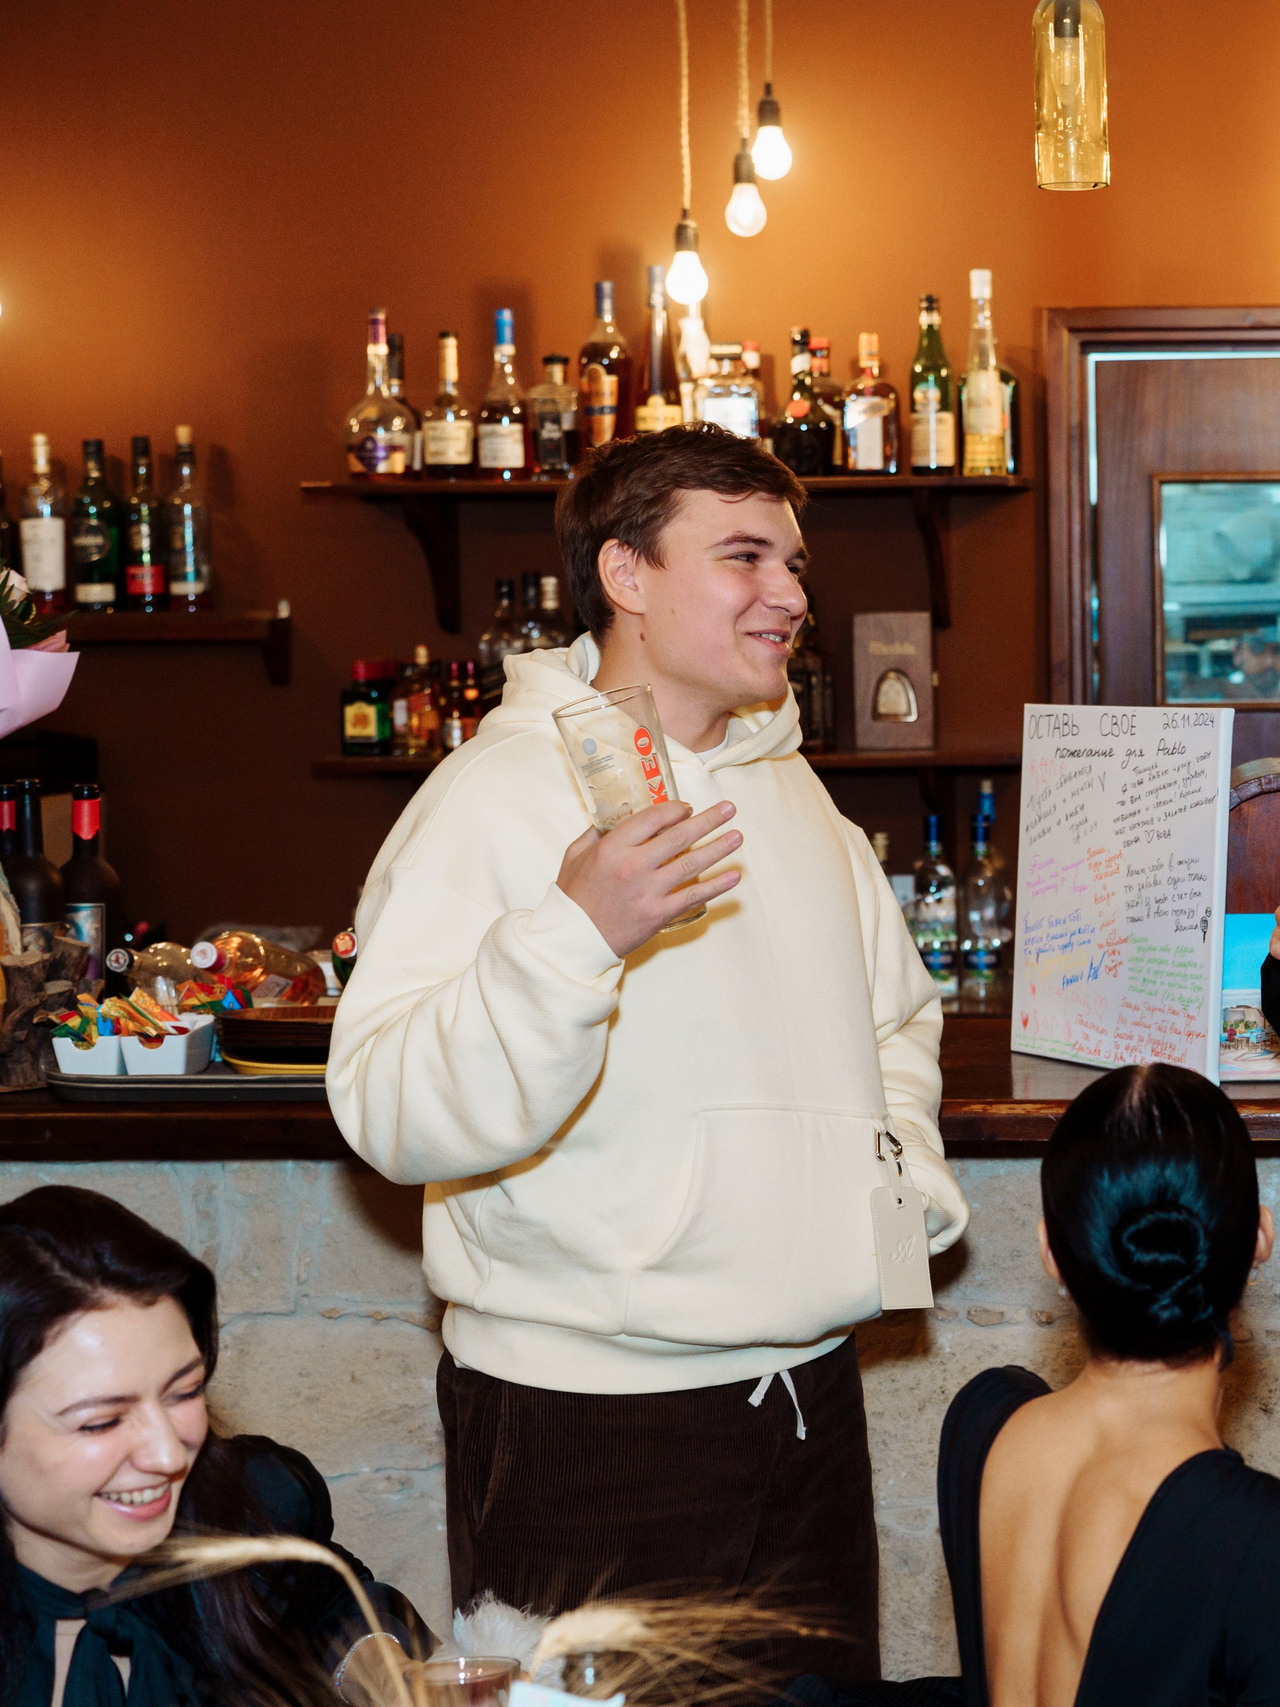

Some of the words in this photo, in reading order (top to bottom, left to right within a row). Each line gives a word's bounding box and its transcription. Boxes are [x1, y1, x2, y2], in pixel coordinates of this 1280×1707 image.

[1028, 713, 1080, 740] ОСТАВЬ
[1162, 713, 1215, 730] 26.11.2024
[633, 726, 669, 805] KEO
[1054, 746, 1116, 759] пожелание
[1121, 749, 1146, 769] для
[1156, 738, 1187, 756] Pablo
